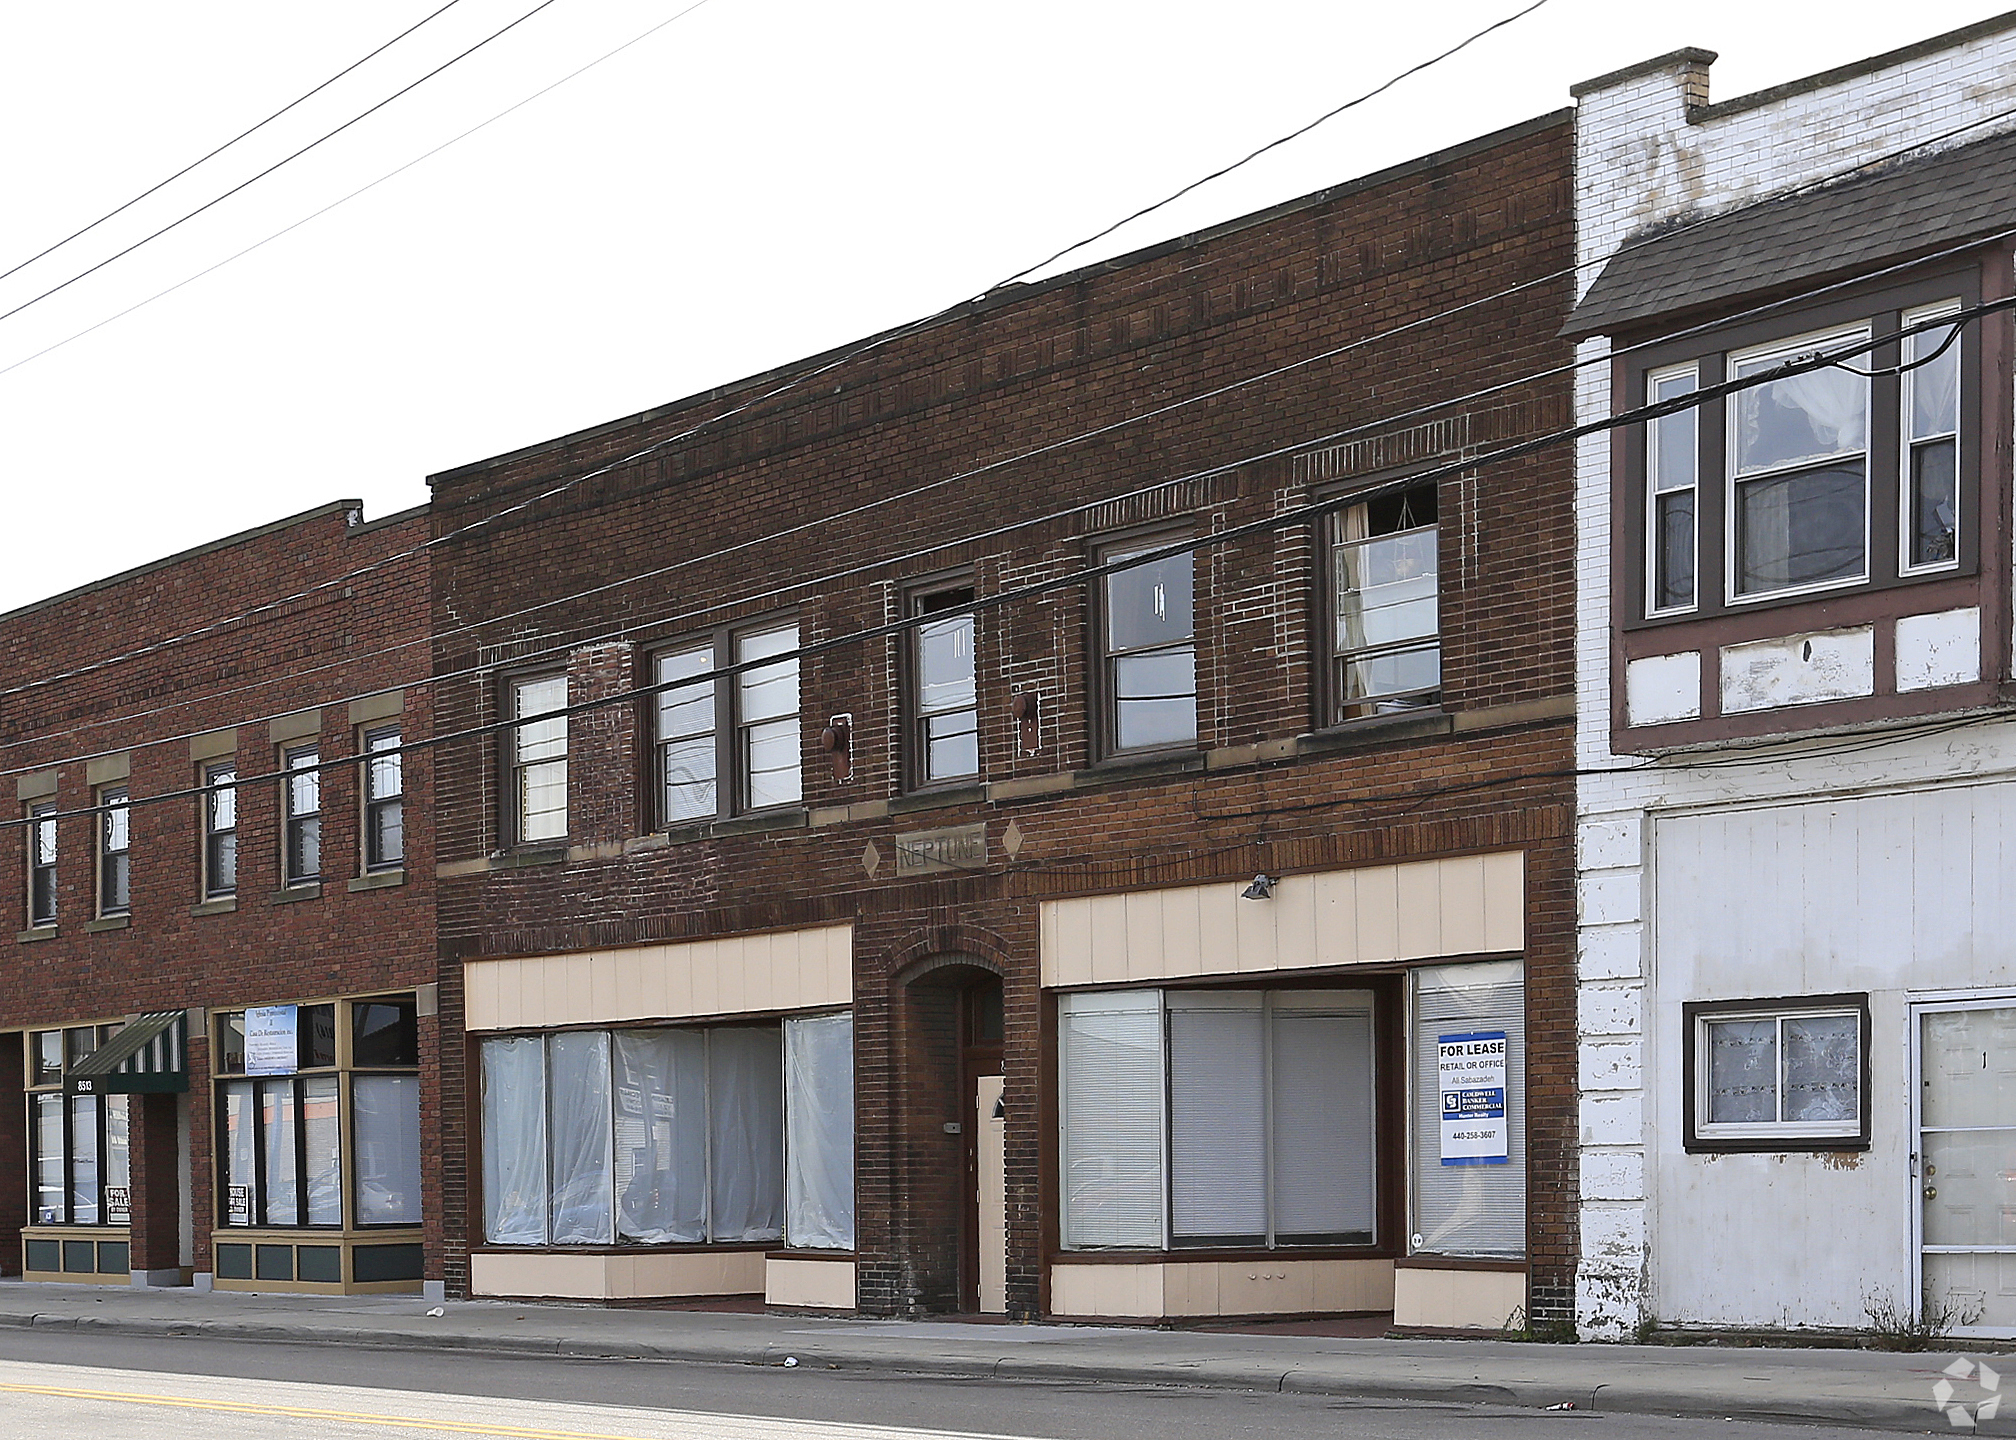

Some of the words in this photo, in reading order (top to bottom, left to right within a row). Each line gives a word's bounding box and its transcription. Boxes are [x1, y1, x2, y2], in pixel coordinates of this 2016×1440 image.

[900, 831, 982, 868] NEPTUNE
[1440, 1045, 1464, 1057] FOR
[1466, 1042, 1504, 1055] LEASE
[1440, 1062, 1465, 1071] RETAIL
[1466, 1061, 1477, 1069] OR
[1479, 1059, 1504, 1068] OFFICE
[78, 1080, 92, 1091] 8513
[110, 1189, 127, 1198] FOR
[109, 1198, 129, 1206] SALE
